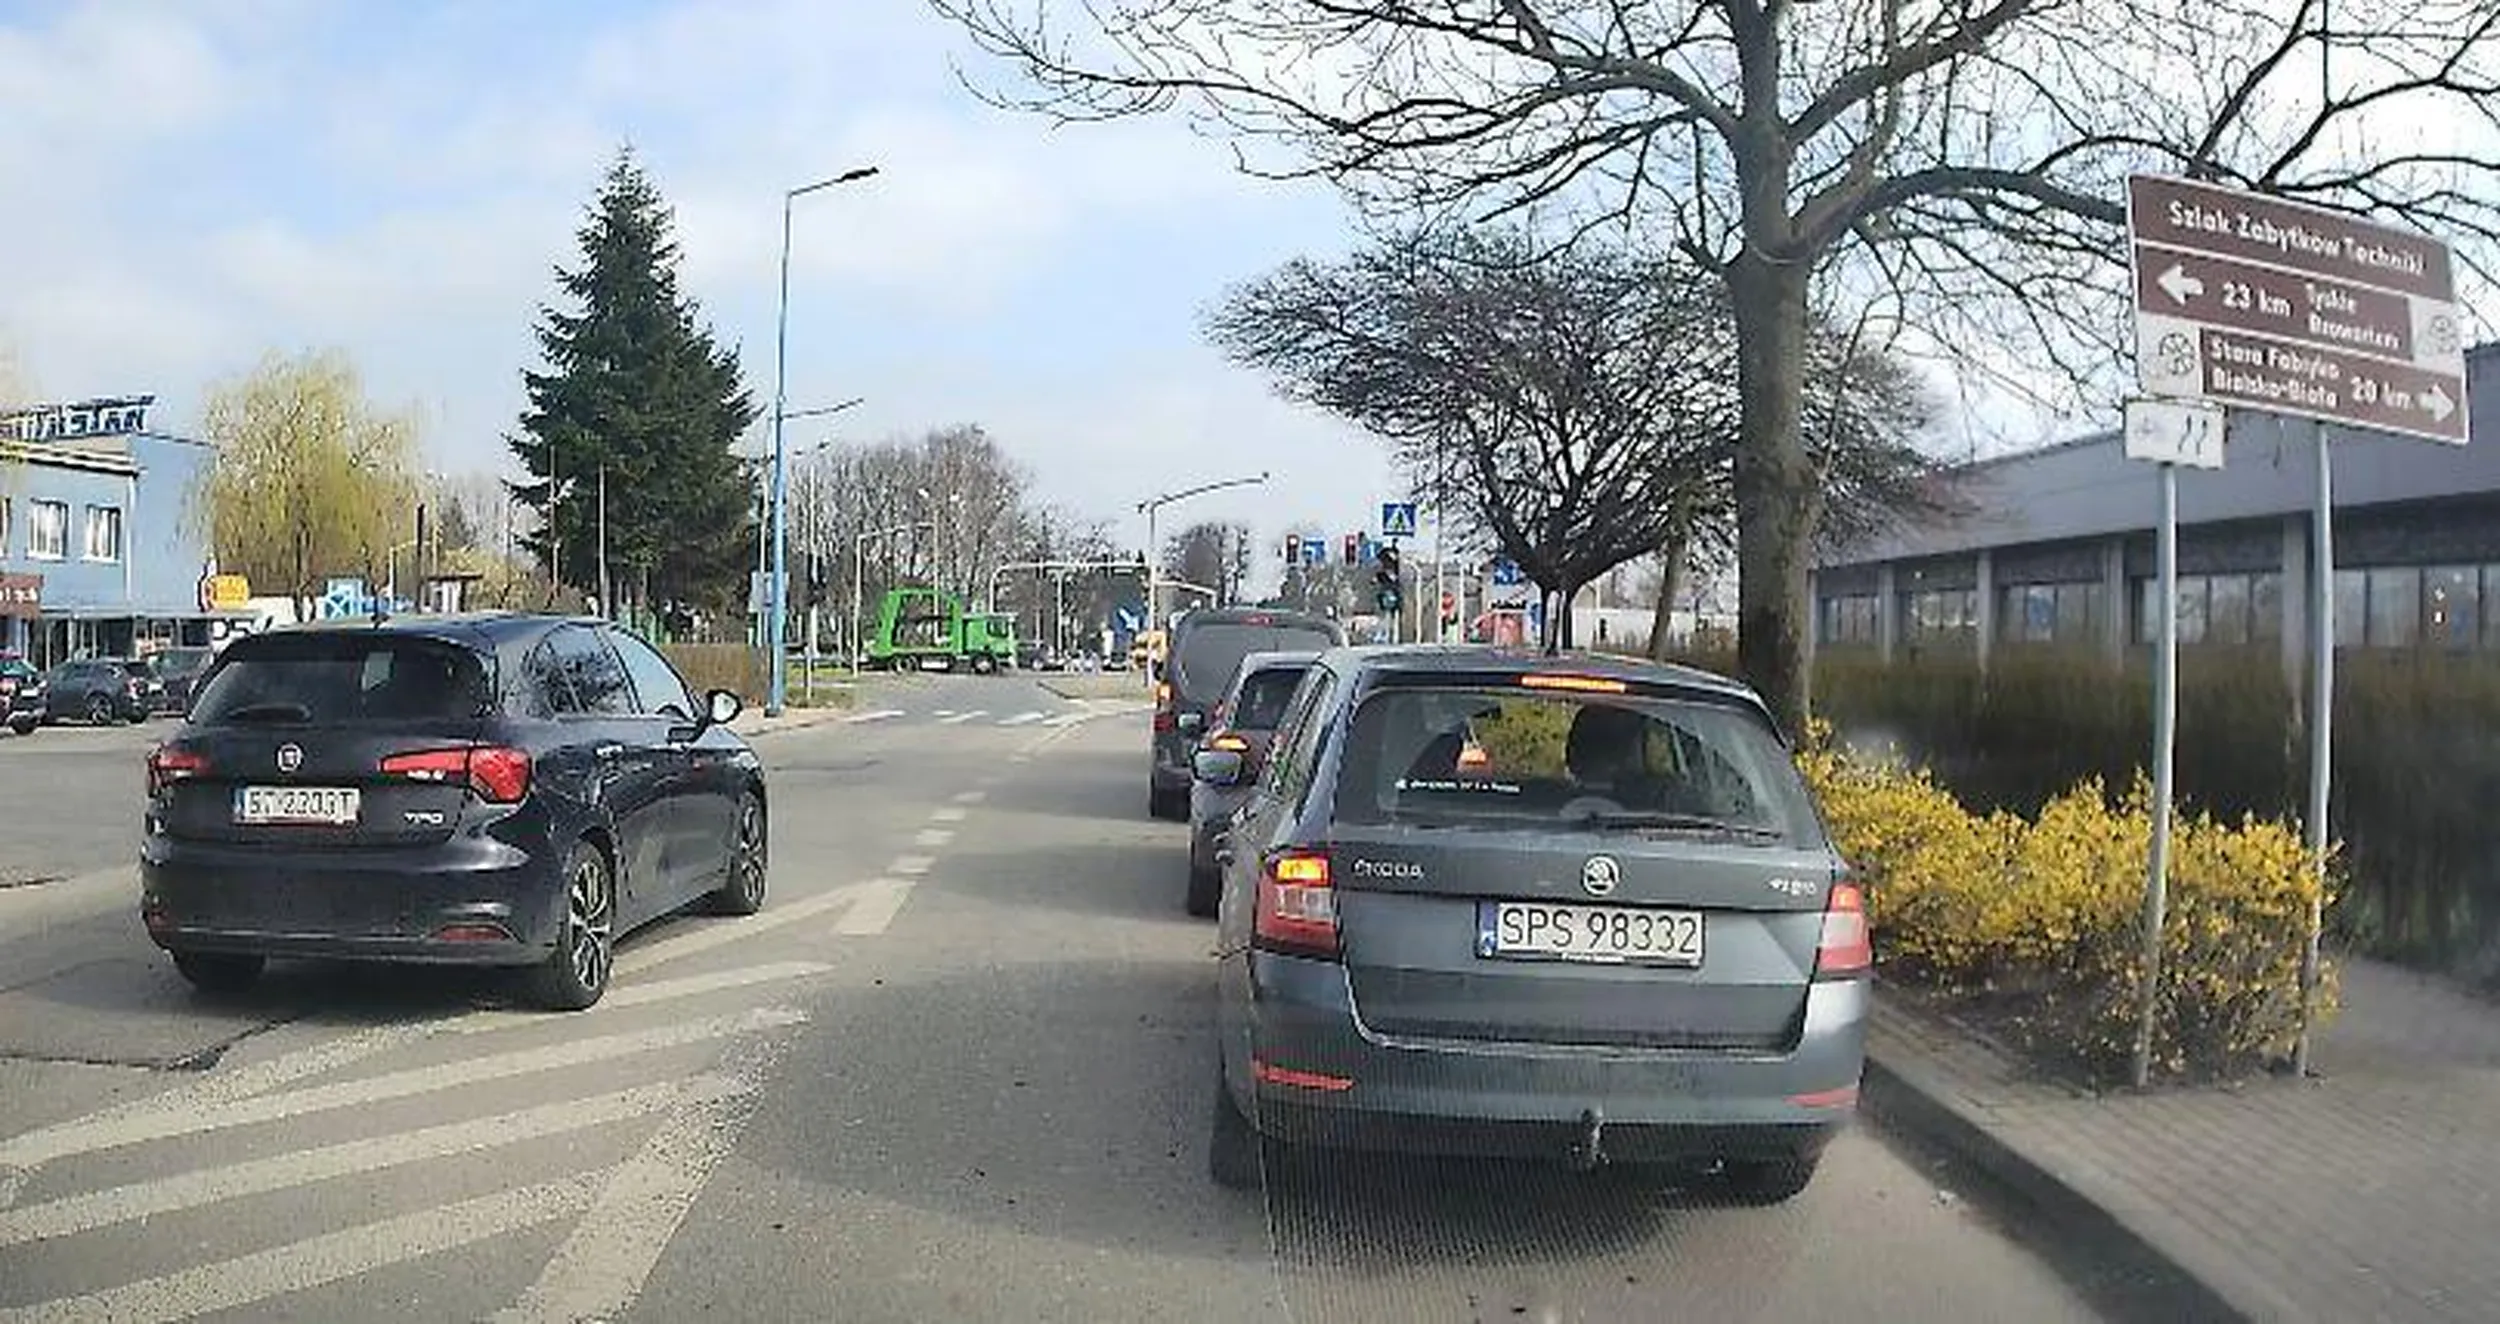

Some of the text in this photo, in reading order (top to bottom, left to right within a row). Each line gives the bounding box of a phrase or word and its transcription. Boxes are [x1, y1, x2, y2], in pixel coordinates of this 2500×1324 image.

[2169, 200, 2231, 233] Szlak
[2223, 281, 2292, 317] 23 km
[2210, 337, 2263, 366] Stara
[2350, 376, 2411, 409] 20 km
[1502, 907, 1698, 954] SPS 98332
